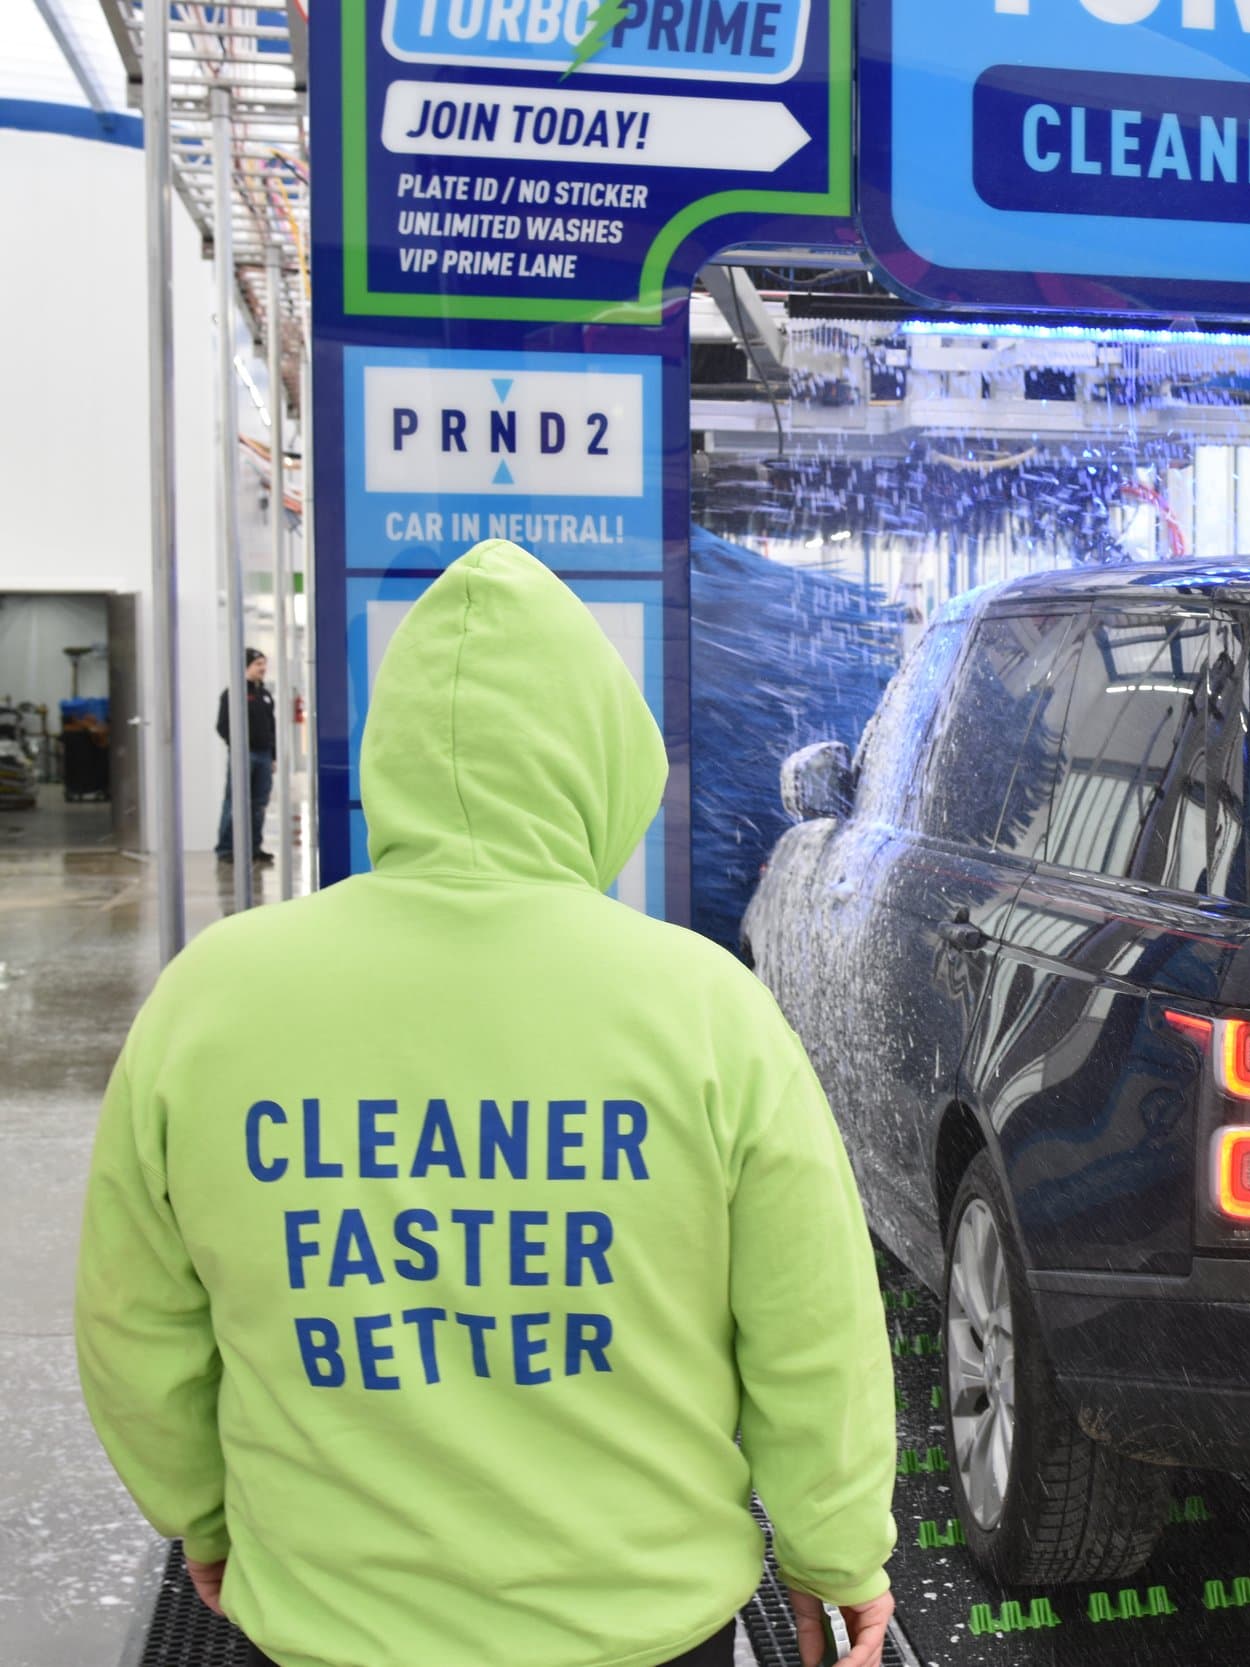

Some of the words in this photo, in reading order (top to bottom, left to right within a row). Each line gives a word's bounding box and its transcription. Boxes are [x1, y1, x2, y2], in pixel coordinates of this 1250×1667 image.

[612, 0, 783, 58] PRIME
[406, 100, 501, 142] JOIN
[513, 105, 650, 150] TODAY!
[398, 173, 470, 200] PLATE
[474, 177, 498, 201] ID
[518, 179, 550, 204] NO
[554, 181, 649, 209] STICKER
[398, 211, 520, 239] UNLIMITED
[526, 216, 624, 244] WASHES
[399, 248, 438, 273] VIP
[441, 250, 514, 276] PRIME
[518, 253, 577, 278] LANE
[385, 512, 443, 542] CAR
[452, 513, 480, 542] IN
[489, 513, 623, 545] NEUTRAL!
[246, 1098, 650, 1182] CLEANER
[284, 1208, 614, 1289] FASTER
[294, 1307, 613, 1390] BETTER
